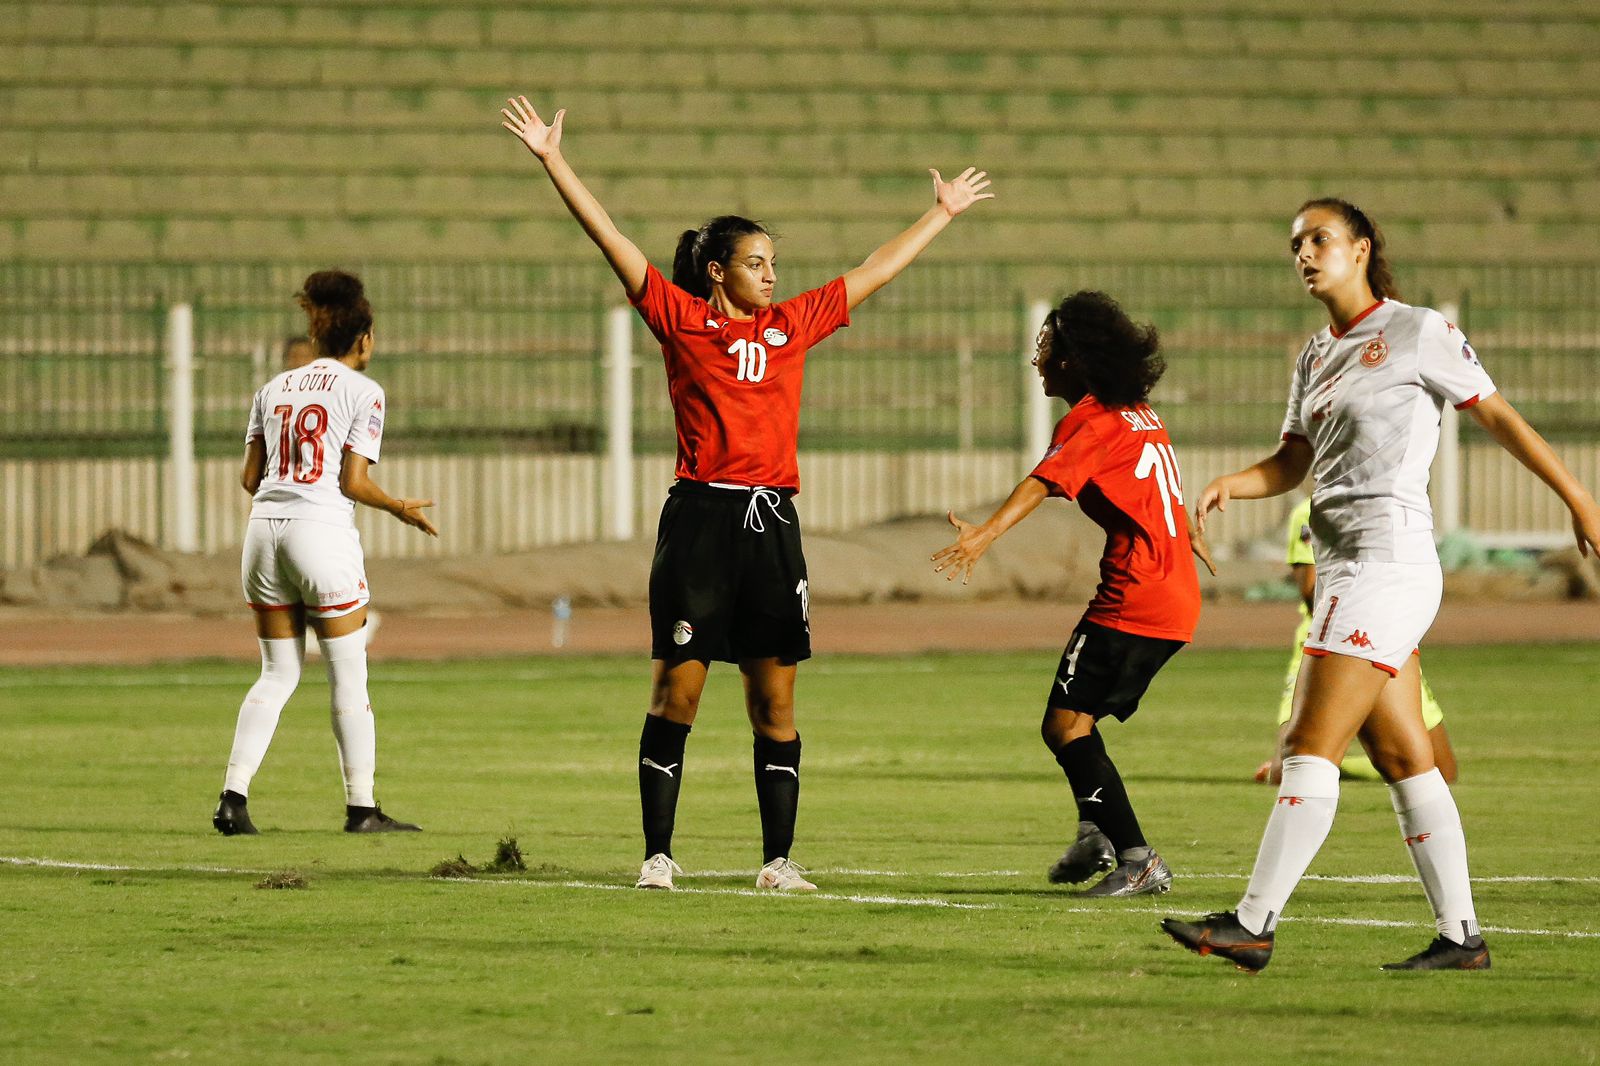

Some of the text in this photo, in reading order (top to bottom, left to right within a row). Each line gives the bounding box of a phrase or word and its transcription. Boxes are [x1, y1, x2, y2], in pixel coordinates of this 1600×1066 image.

[282, 373, 338, 392] S. OUNI
[727, 338, 767, 383] 10
[1120, 408, 1163, 431] SALLY
[274, 404, 328, 484] 18
[1134, 442, 1184, 537] 14
